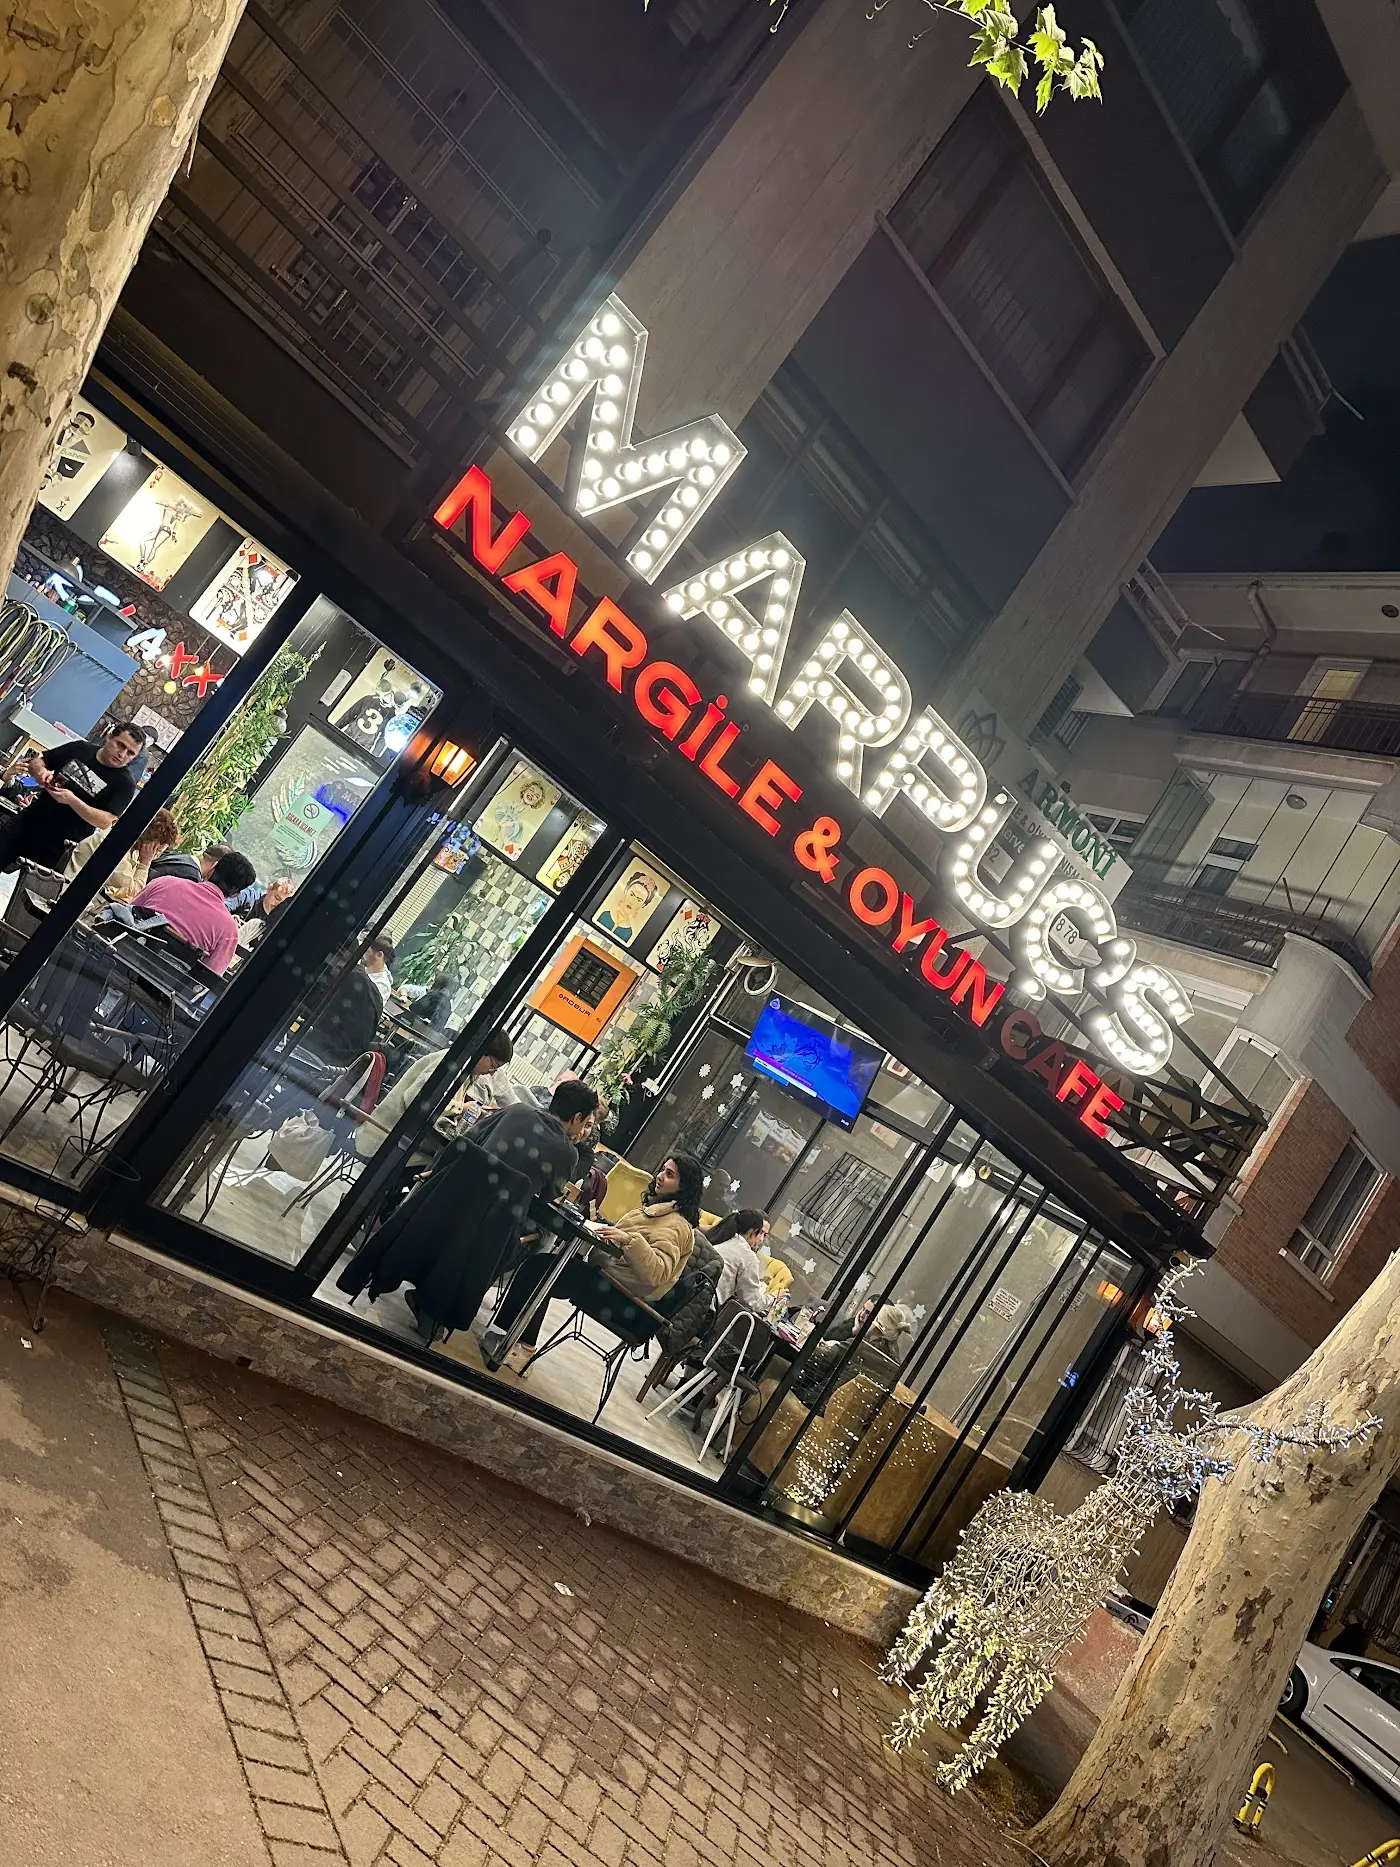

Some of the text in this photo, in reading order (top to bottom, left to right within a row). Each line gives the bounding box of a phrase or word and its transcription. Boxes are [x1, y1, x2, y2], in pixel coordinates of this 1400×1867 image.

[357, 708, 384, 735] 3
[433, 464, 1125, 1139] NARGİLE & OYUN CAFE
[1017, 767, 1118, 881] ARMONİ
[1063, 927, 1079, 945] 78
